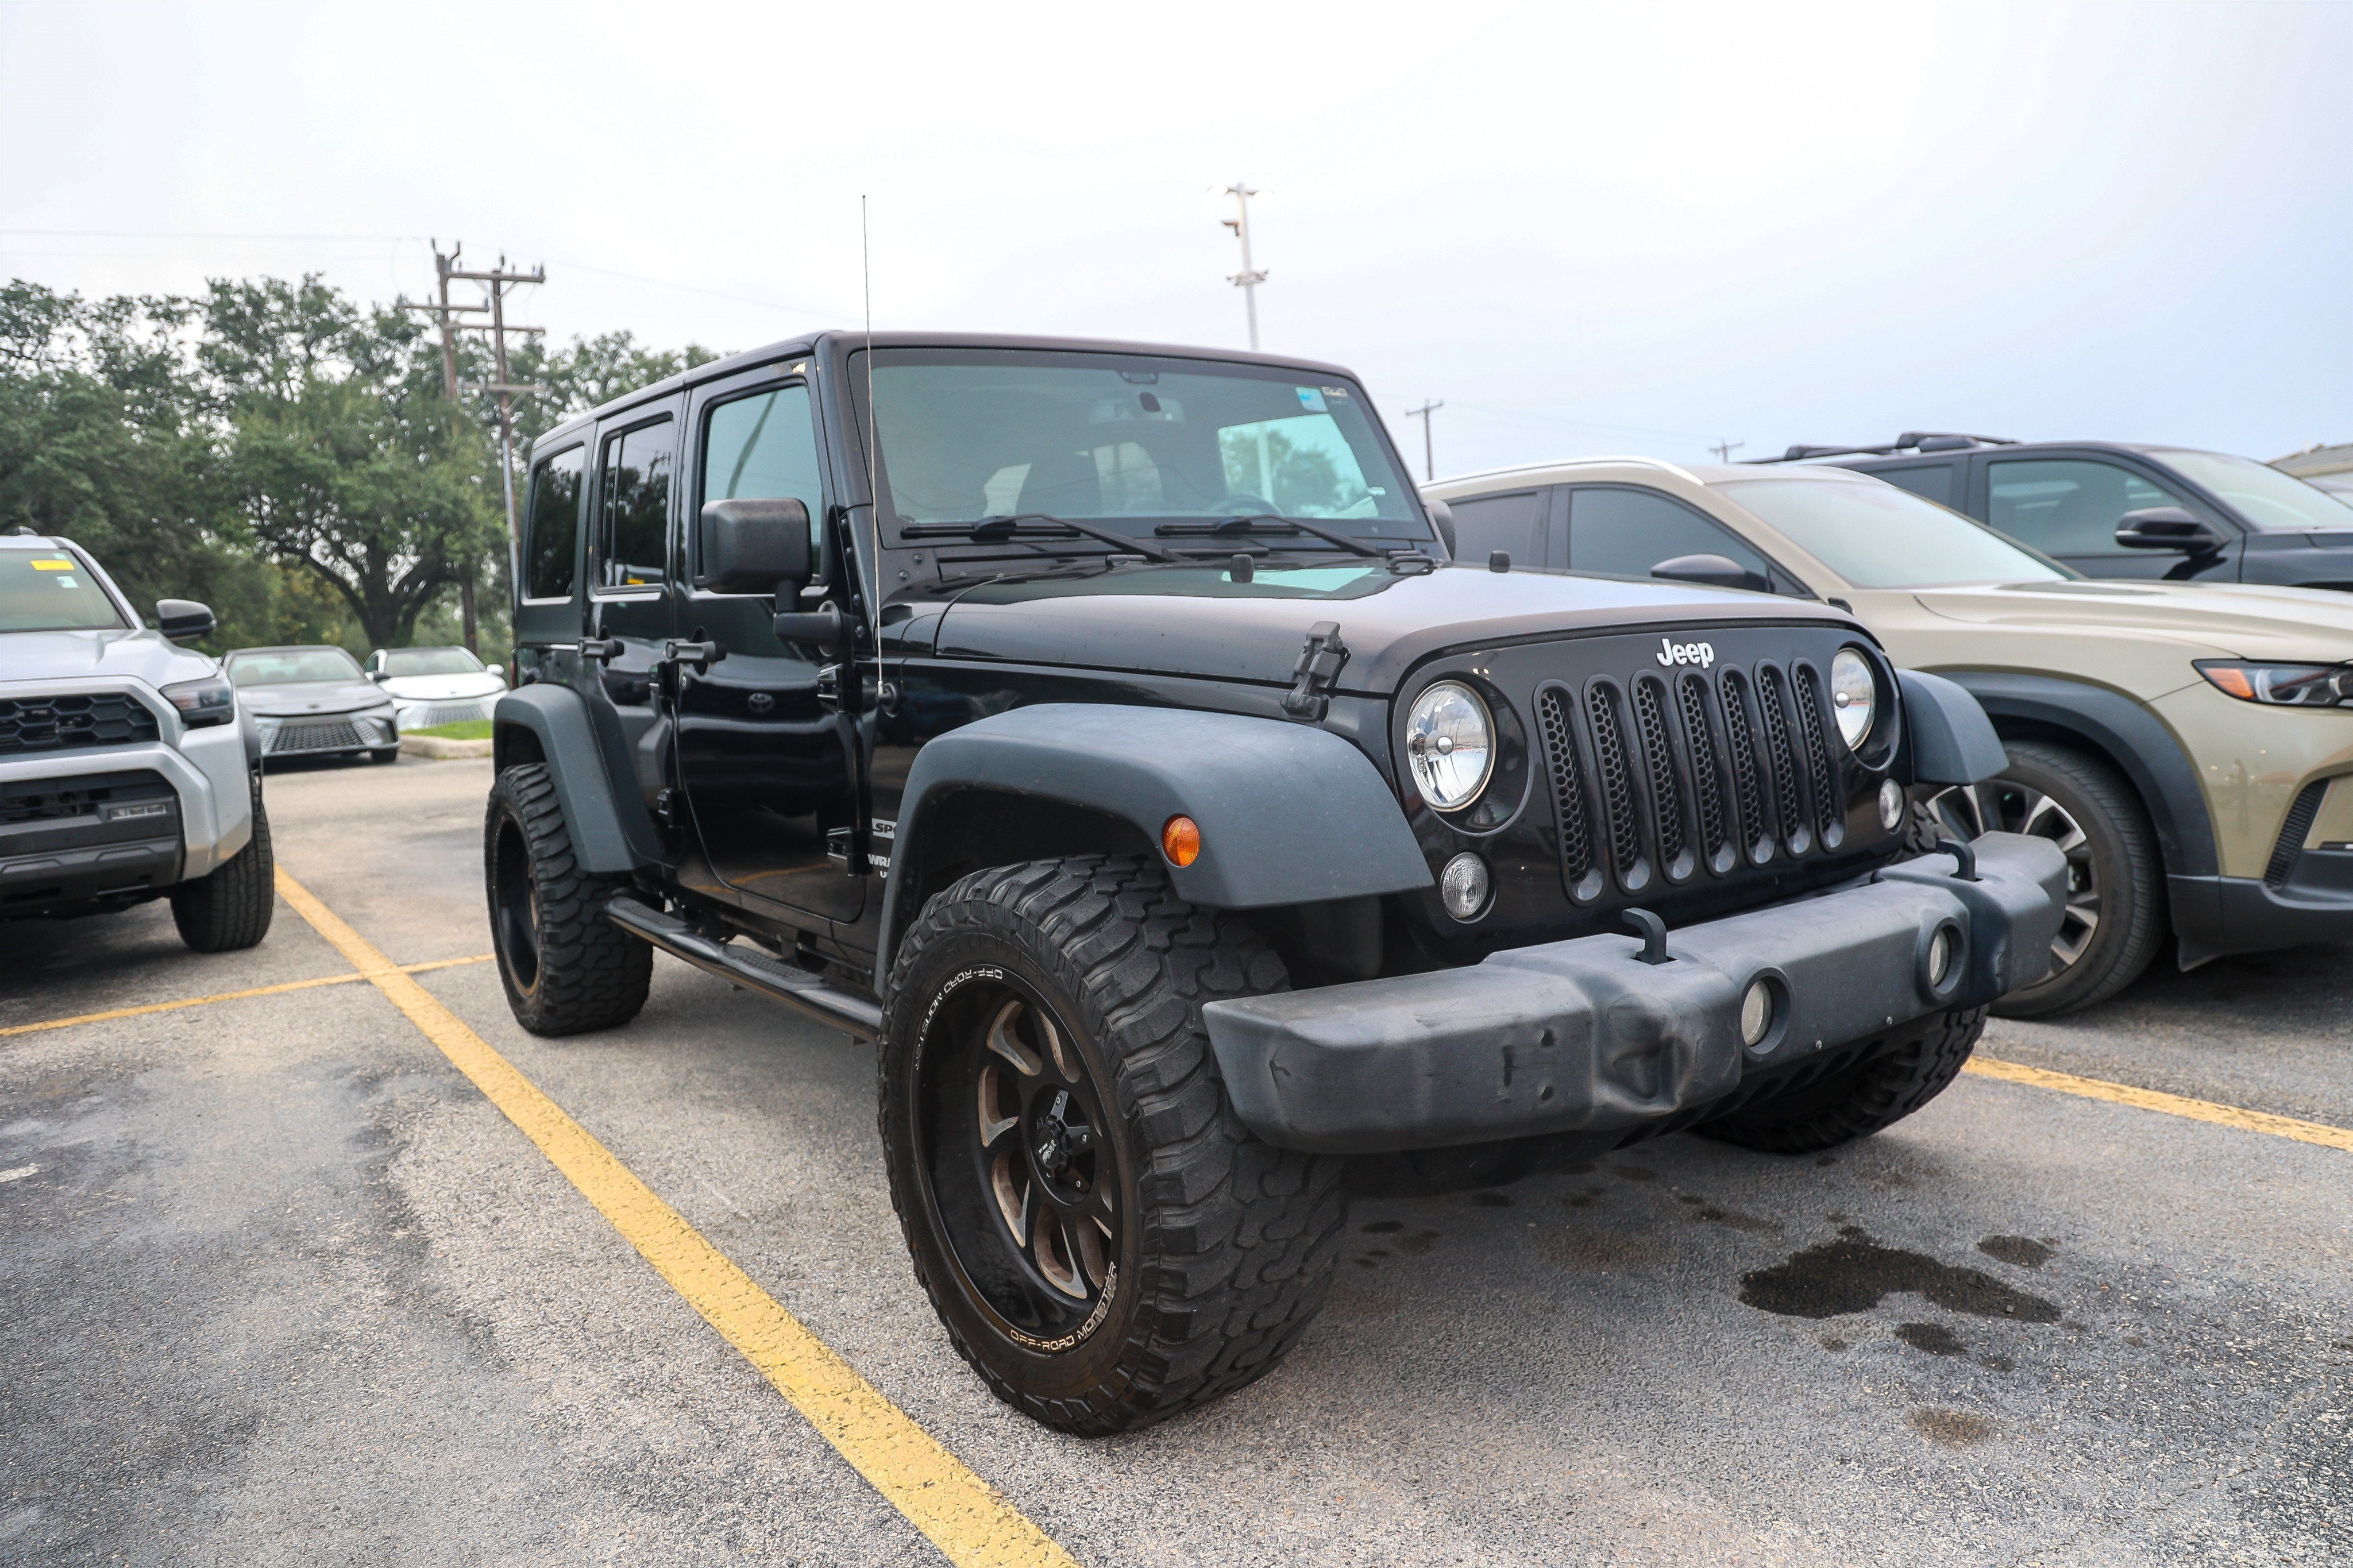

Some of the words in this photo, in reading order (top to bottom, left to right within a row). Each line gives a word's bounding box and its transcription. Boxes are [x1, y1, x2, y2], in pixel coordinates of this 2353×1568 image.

[1656, 638, 1715, 669] Jeep
[943, 967, 1003, 994] OFF-ROAD
[1010, 1329, 1075, 1351] OFF-ROAD
[1077, 1261, 1117, 1341] MONSTER
